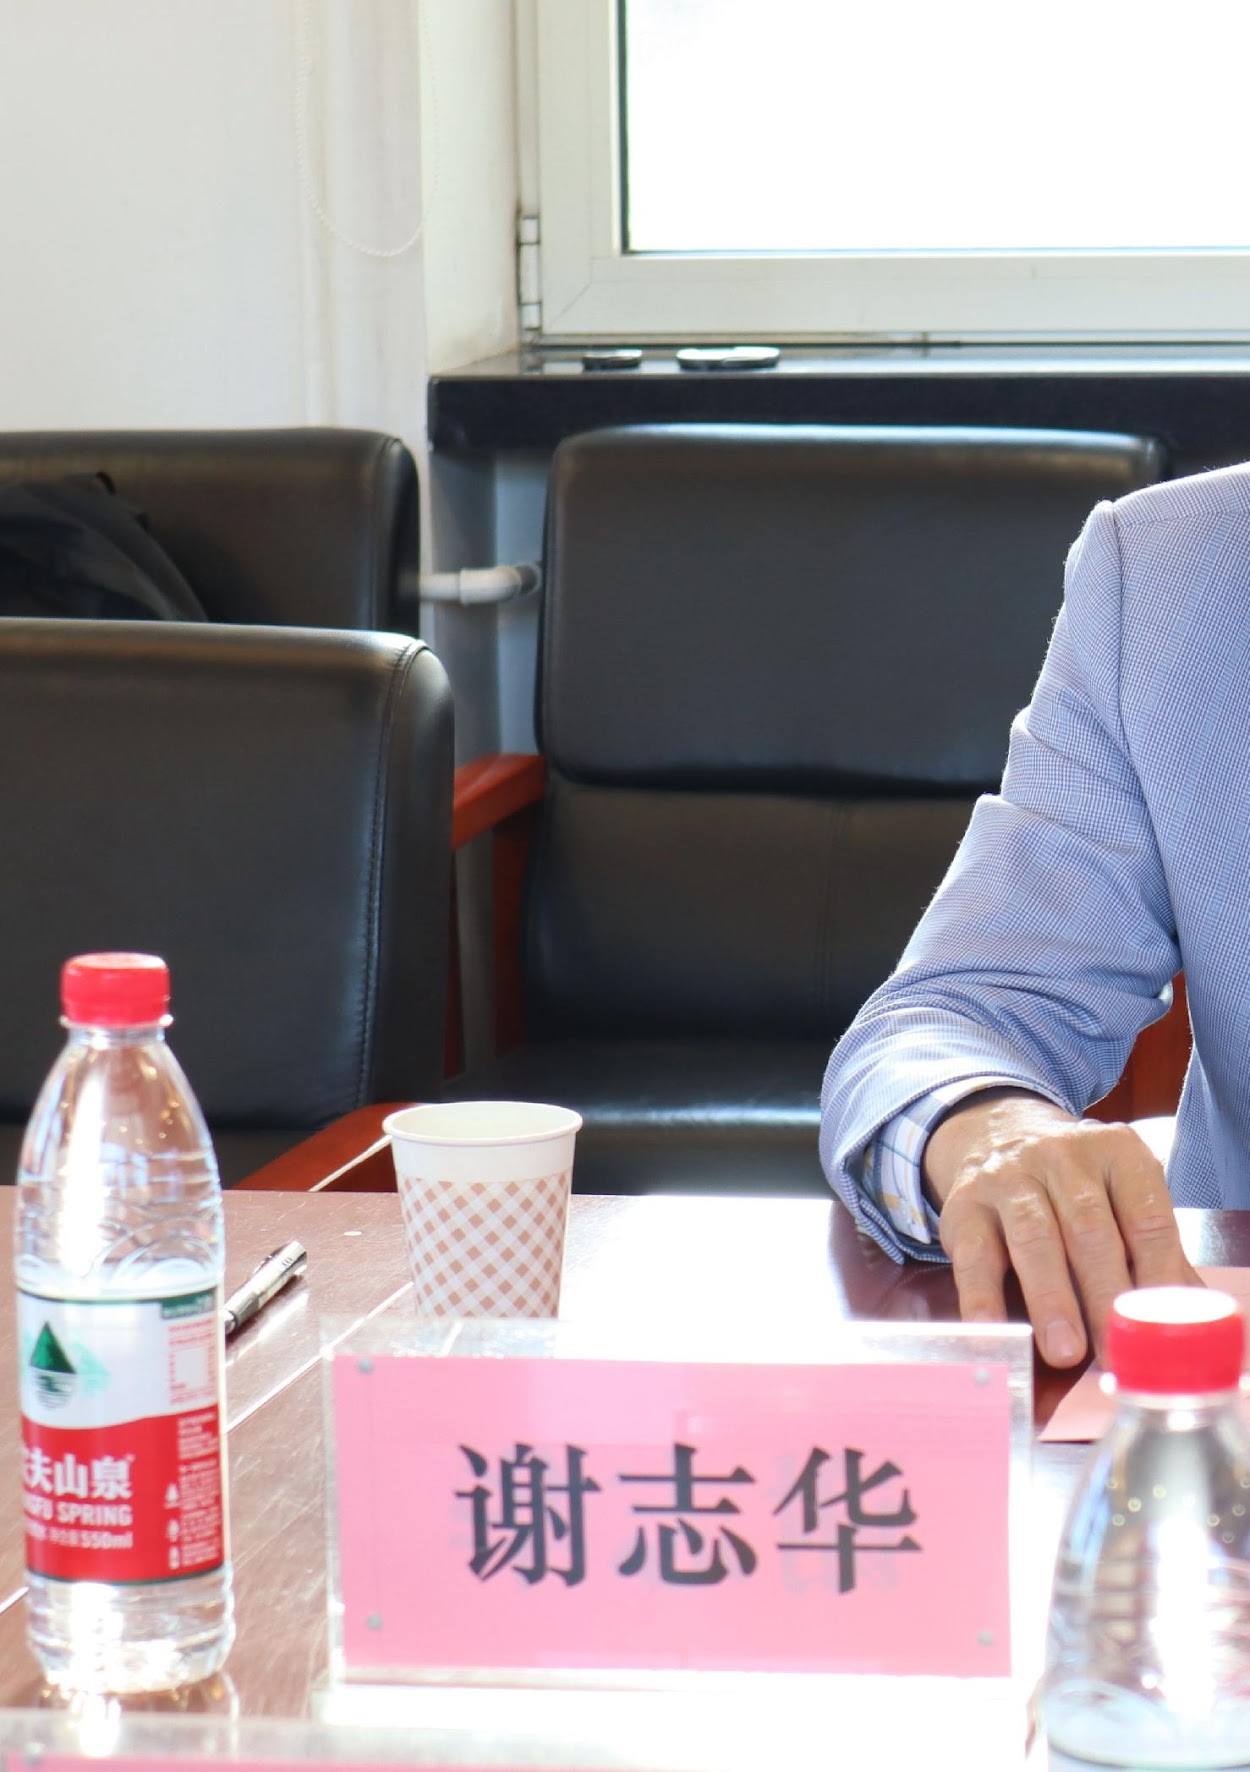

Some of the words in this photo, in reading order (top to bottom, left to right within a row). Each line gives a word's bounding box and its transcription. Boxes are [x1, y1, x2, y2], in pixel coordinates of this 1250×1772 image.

[24, 1447, 132, 1500] 夫山泉
[57, 1501, 132, 1527] SPRING
[454, 1442, 922, 1594] 谢志华
